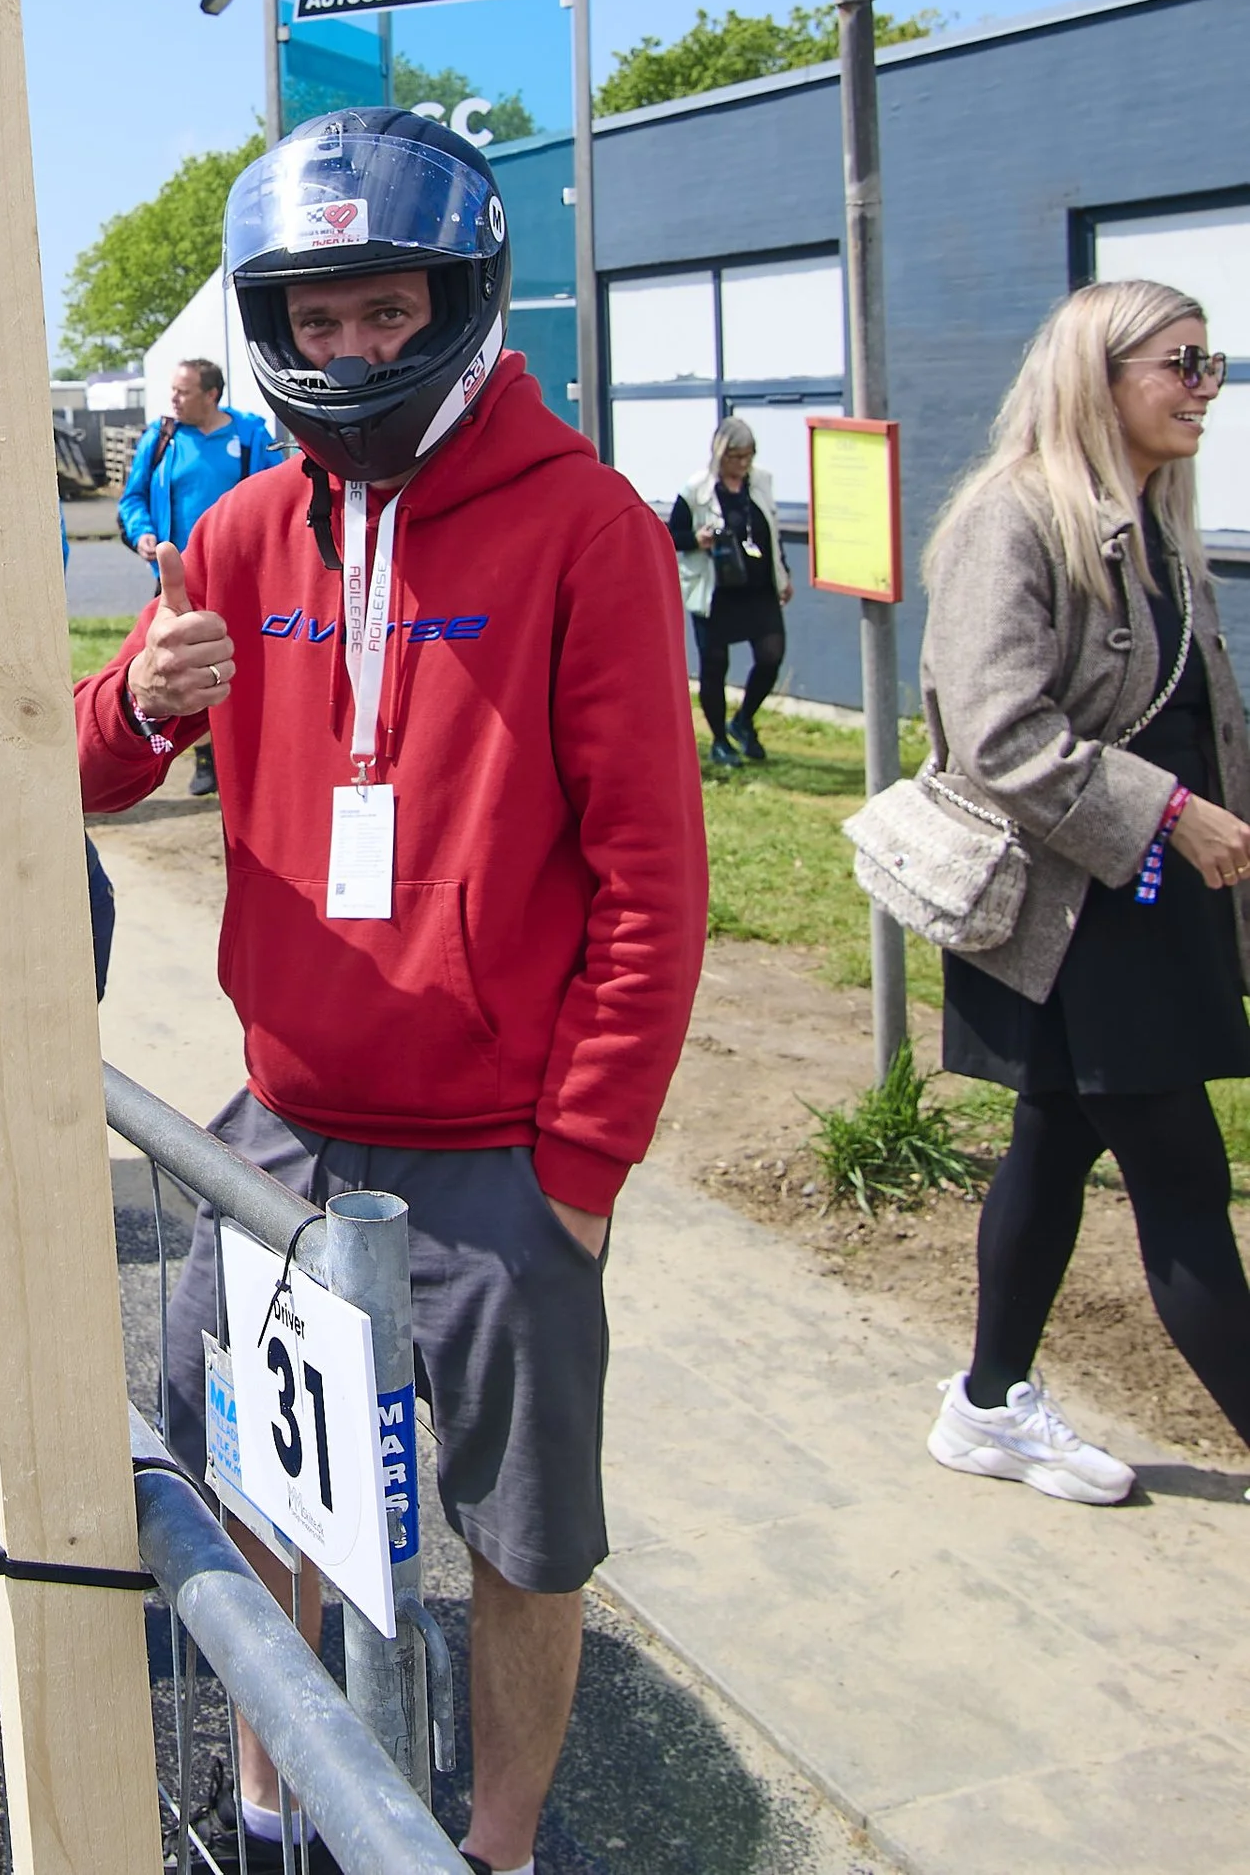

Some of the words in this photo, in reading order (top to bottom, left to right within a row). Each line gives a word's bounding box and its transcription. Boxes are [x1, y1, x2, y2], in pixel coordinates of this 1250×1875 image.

[260, 607, 489, 644] divrse
[350, 565, 363, 654] AGILEASE
[368, 561, 388, 653] AGILEASE
[267, 1336, 334, 1514] 31
